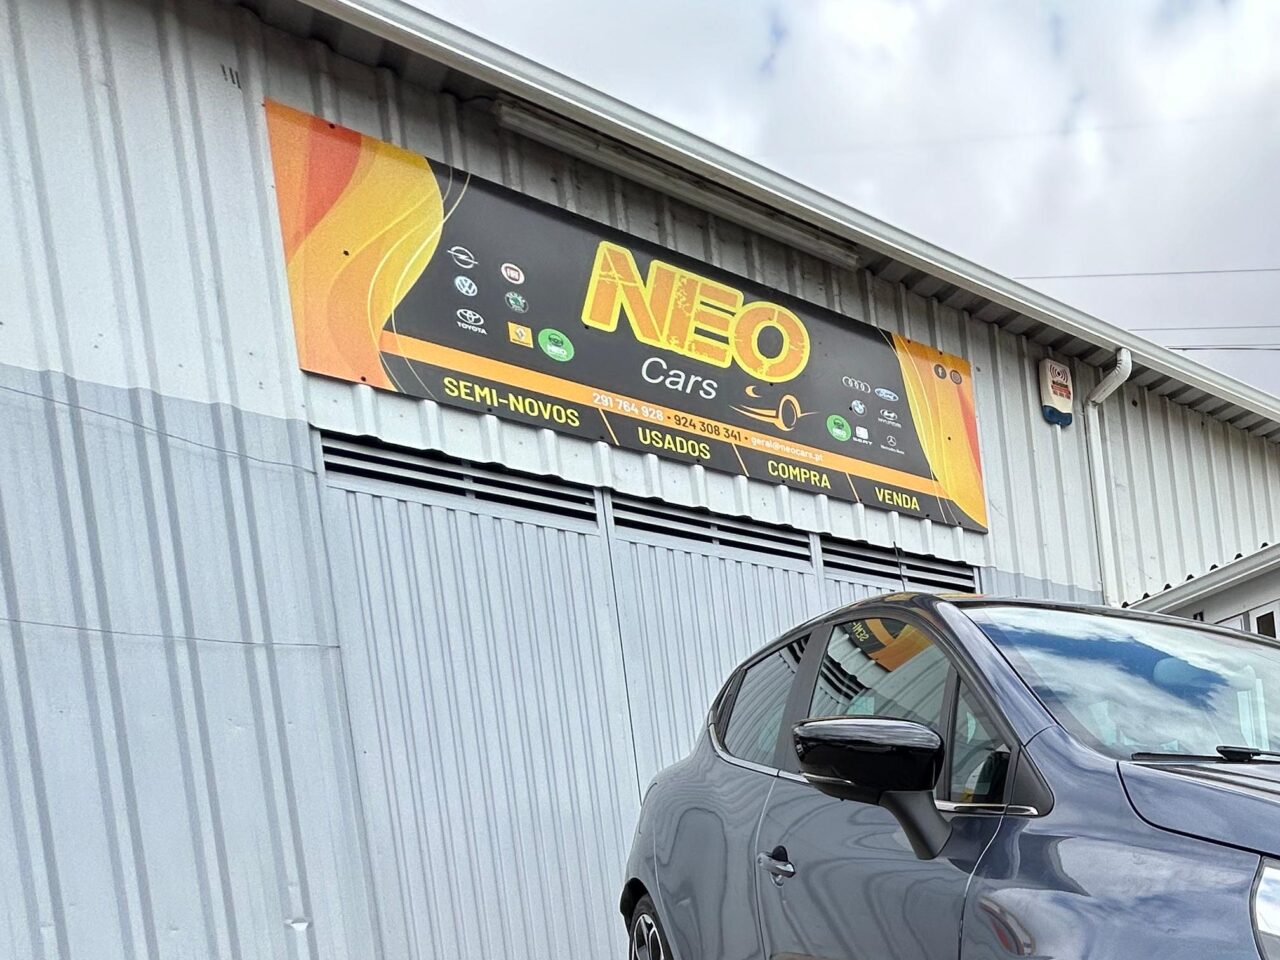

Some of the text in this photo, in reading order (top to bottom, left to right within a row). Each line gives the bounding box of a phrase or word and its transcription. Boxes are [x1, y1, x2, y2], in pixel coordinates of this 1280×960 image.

[456, 321, 488, 335] TOYOTA
[581, 240, 811, 383] NEO
[641, 357, 718, 399] Cars
[443, 376, 580, 427] SEMI-NOVOS
[592, 391, 824, 463] 291 764 928 924 308 341 geral@neocars.pt
[637, 426, 711, 460] USADOS
[767, 460, 831, 489] COMPRA
[874, 486, 920, 511] VENDA
